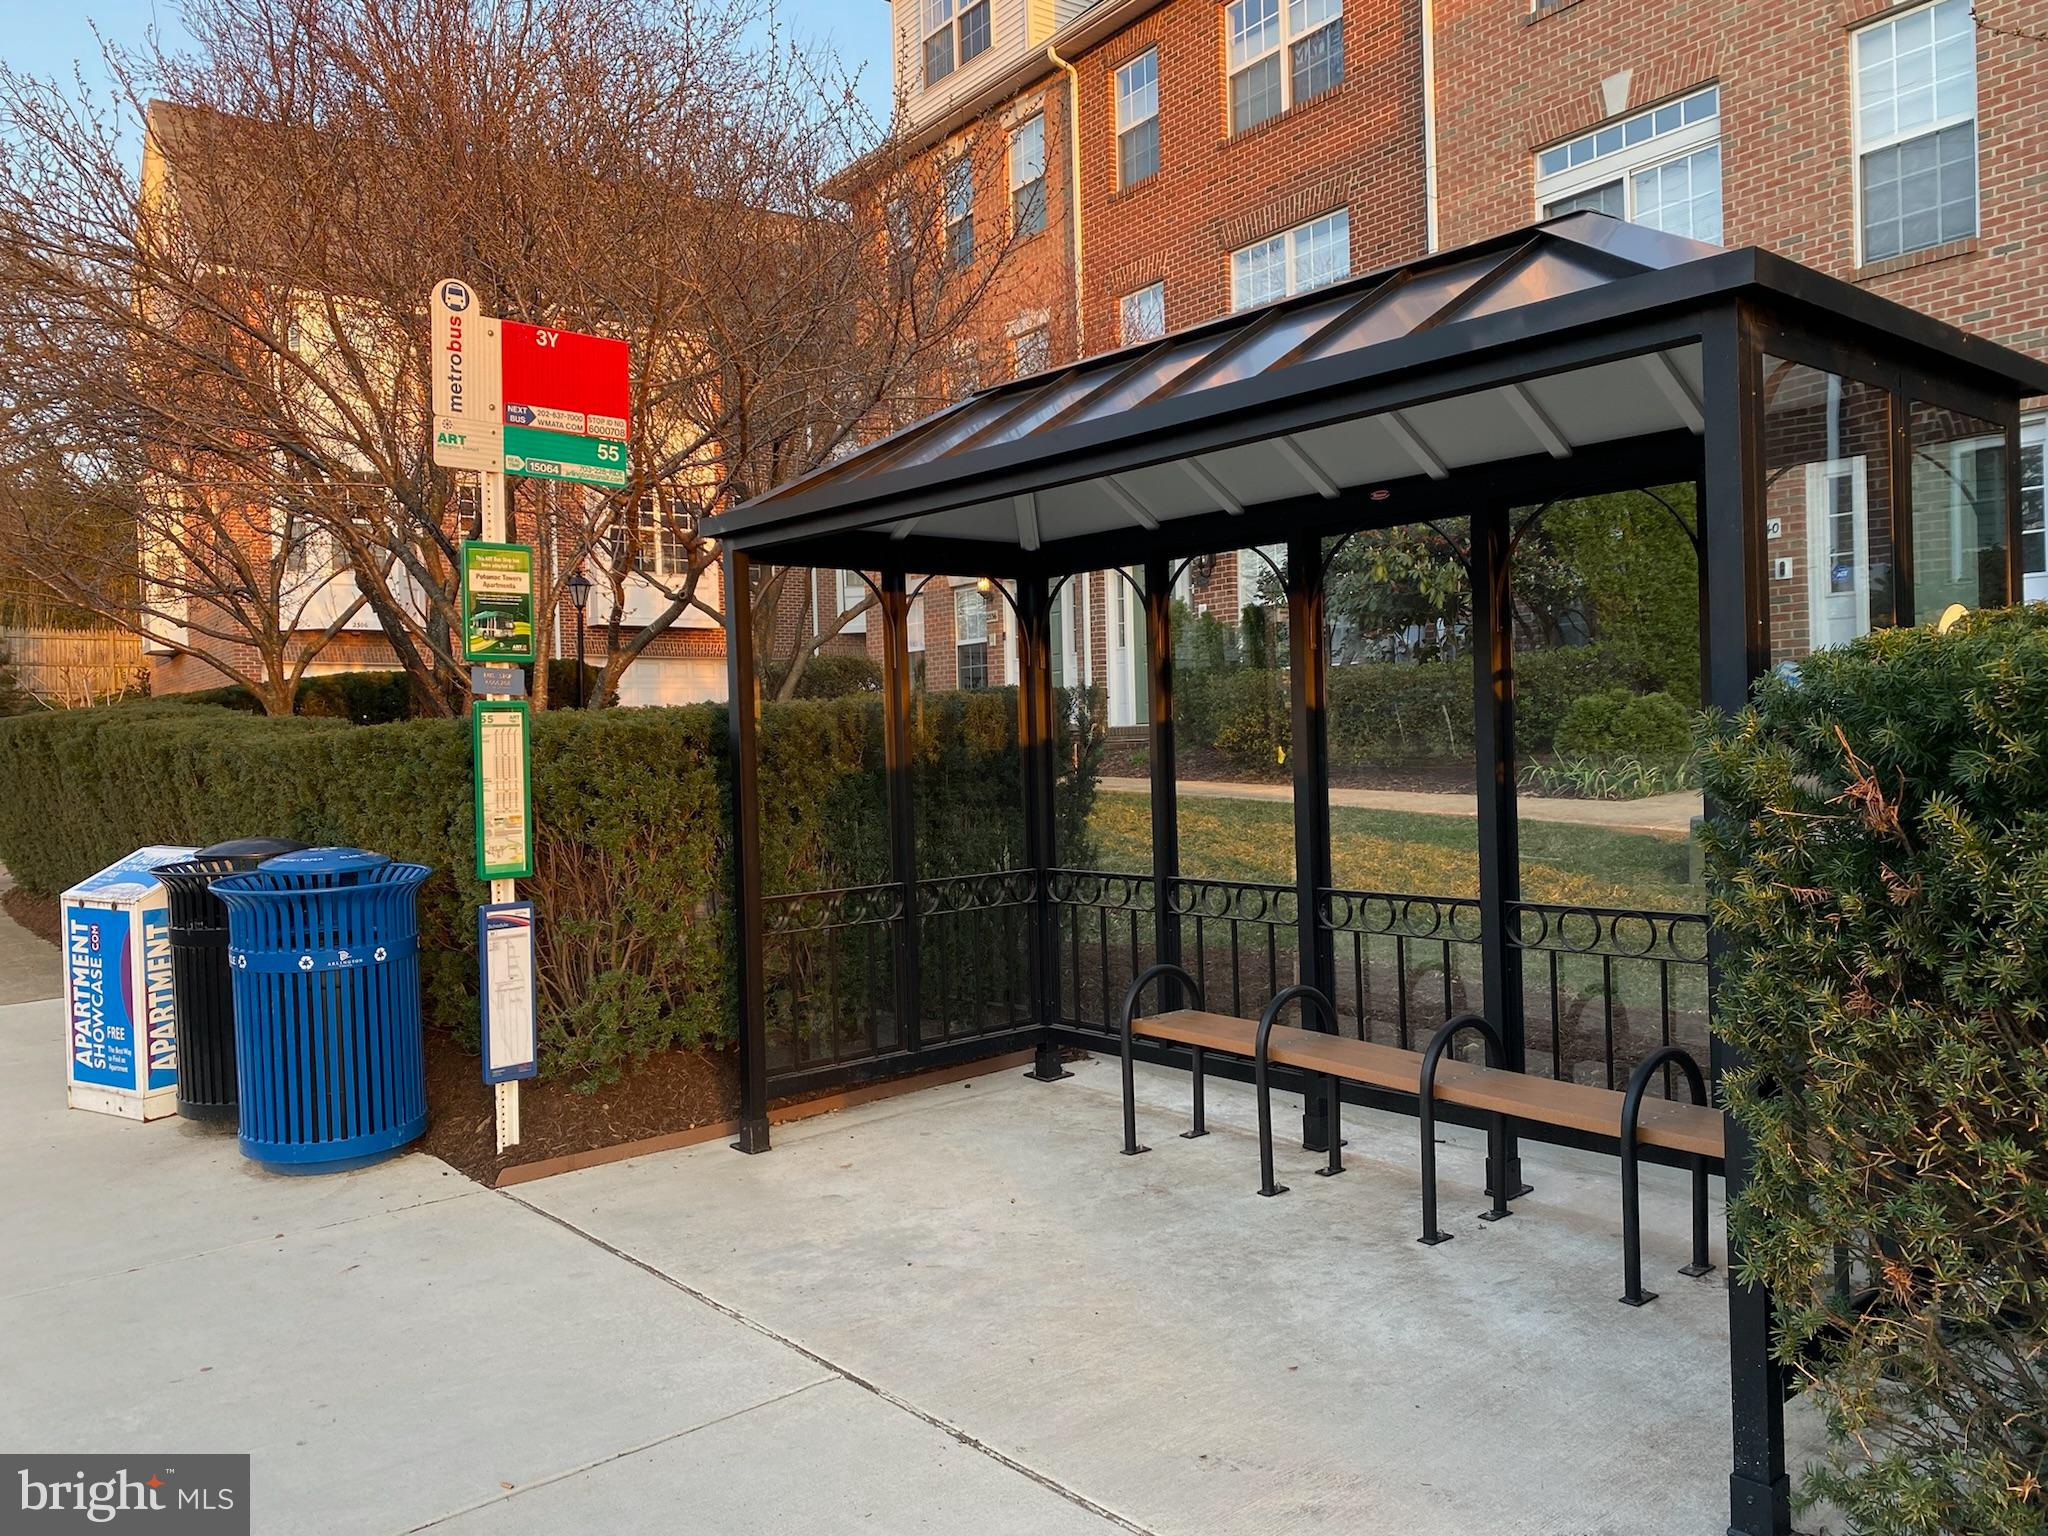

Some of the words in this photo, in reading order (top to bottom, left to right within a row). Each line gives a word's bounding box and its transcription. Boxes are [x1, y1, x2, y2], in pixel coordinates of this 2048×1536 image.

[535, 329, 559, 347] 3Y
[447, 315, 462, 413] metrobus
[507, 405, 528, 414] NEXT
[509, 414, 526, 424] BUS
[588, 416, 606, 425] STOP
[588, 425, 626, 437] 6000708
[437, 432, 467, 445] ART
[597, 443, 620, 462] 55
[529, 462, 559, 474] 15064
[502, 574, 522, 582] Towers
[482, 581, 516, 589] Apartments
[71, 919, 95, 1069] APARTMENT
[145, 924, 177, 1070] APARTMENT
[107, 1025, 126, 1040] FREE
[123, 1047, 132, 1057] Way
[108, 1064, 129, 1073] Apartment
